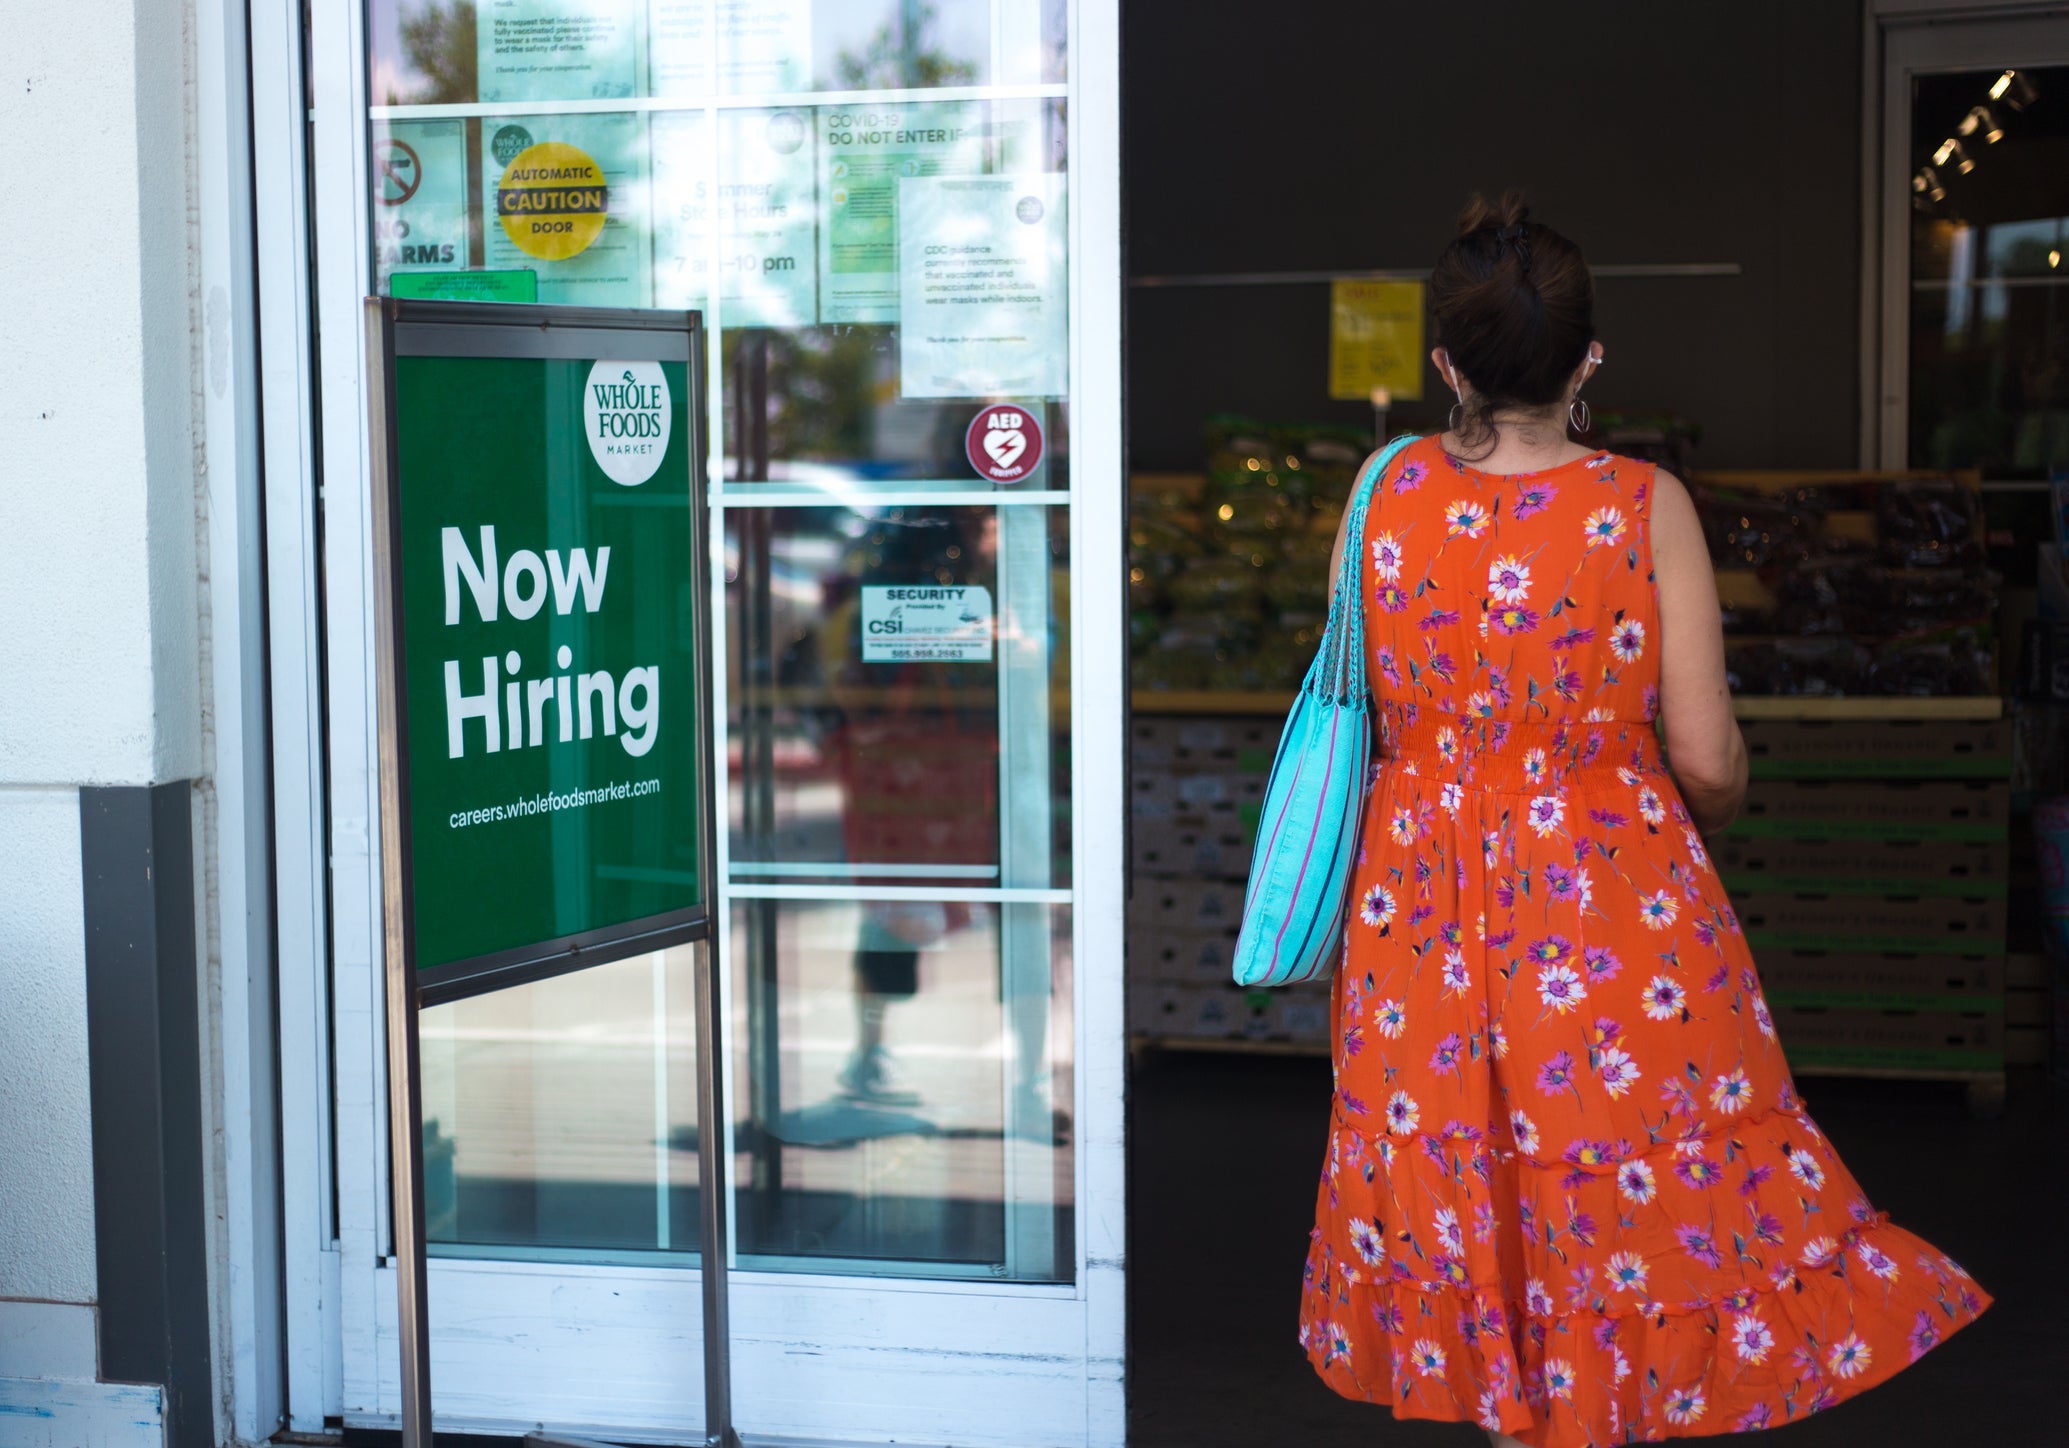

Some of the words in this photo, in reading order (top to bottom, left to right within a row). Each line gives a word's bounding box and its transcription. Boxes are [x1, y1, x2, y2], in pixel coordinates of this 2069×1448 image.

[828, 114, 899, 128] COVID-19
[828, 131, 853, 145] DO
[857, 130, 892, 144] NOT
[896, 129, 945, 143] ENTER
[511, 167, 593, 181] AUTOMATIC
[696, 180, 772, 198] Smmer
[504, 190, 602, 212] CAUTION
[531, 221, 574, 234] DOOR
[924, 245, 947, 255] CDC
[763, 256, 796, 275] pm
[593, 383, 662, 410] WHOLE
[599, 413, 661, 437] FOODS
[987, 413, 1023, 430] AED
[606, 444, 653, 454] MARKET
[441, 524, 611, 626] Now
[886, 589, 965, 600] SECURITY
[444, 645, 660, 759] Hiring
[449, 778, 660, 829] careers.wholefoodsmarket.com
